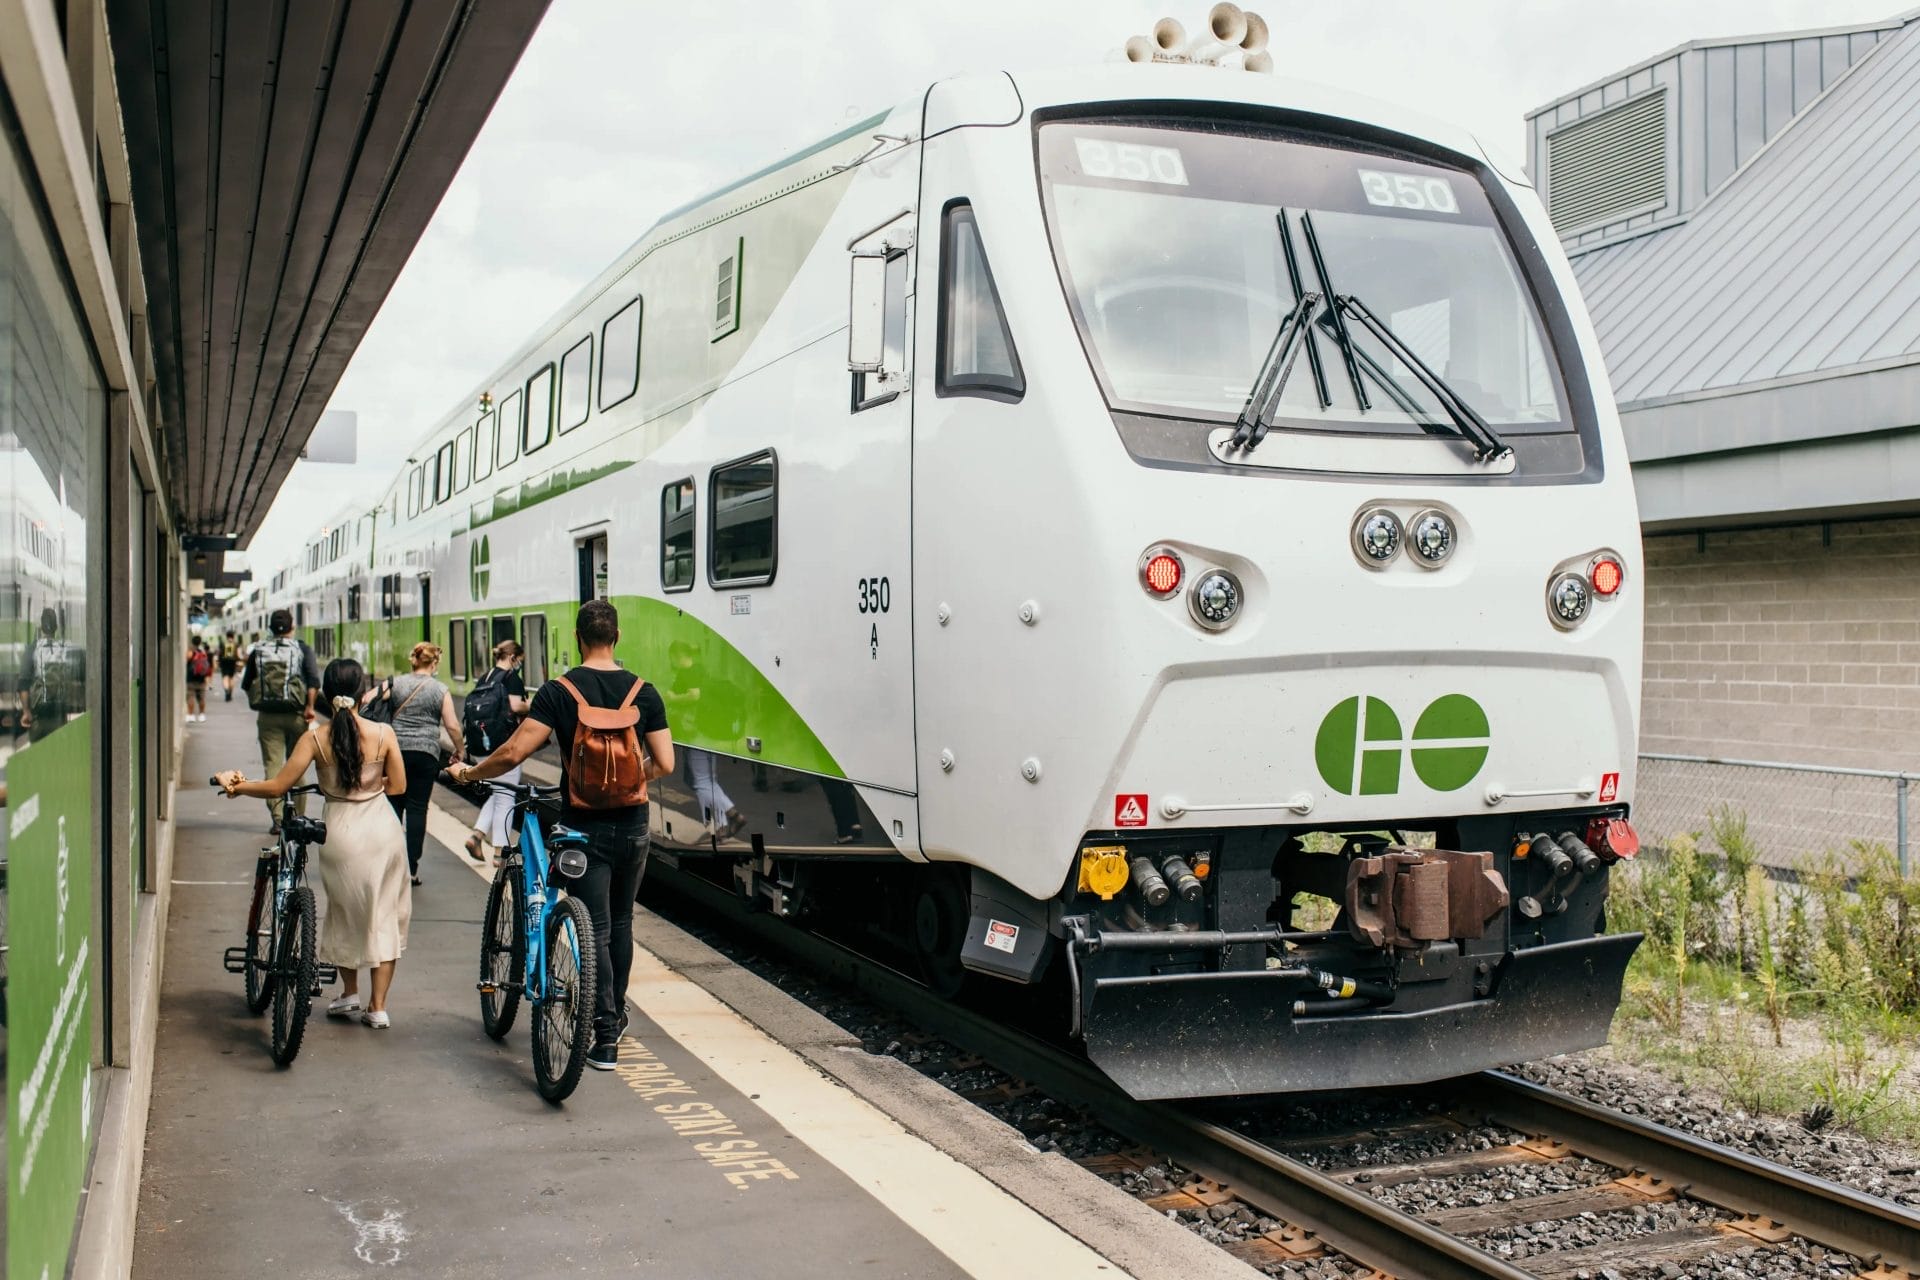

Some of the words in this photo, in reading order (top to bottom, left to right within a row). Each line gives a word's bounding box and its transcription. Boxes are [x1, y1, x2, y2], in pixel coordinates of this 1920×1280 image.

[1078, 140, 1184, 184] 350
[1361, 171, 1457, 213] 350
[858, 576, 890, 613] 350
[870, 622, 879, 647] A
[1315, 693, 1490, 796] GO
[616, 1036, 658, 1060] TAY
[615, 1063, 697, 1101] BACK.
[654, 1102, 743, 1136] STAY
[693, 1139, 800, 1190] SAFE.
